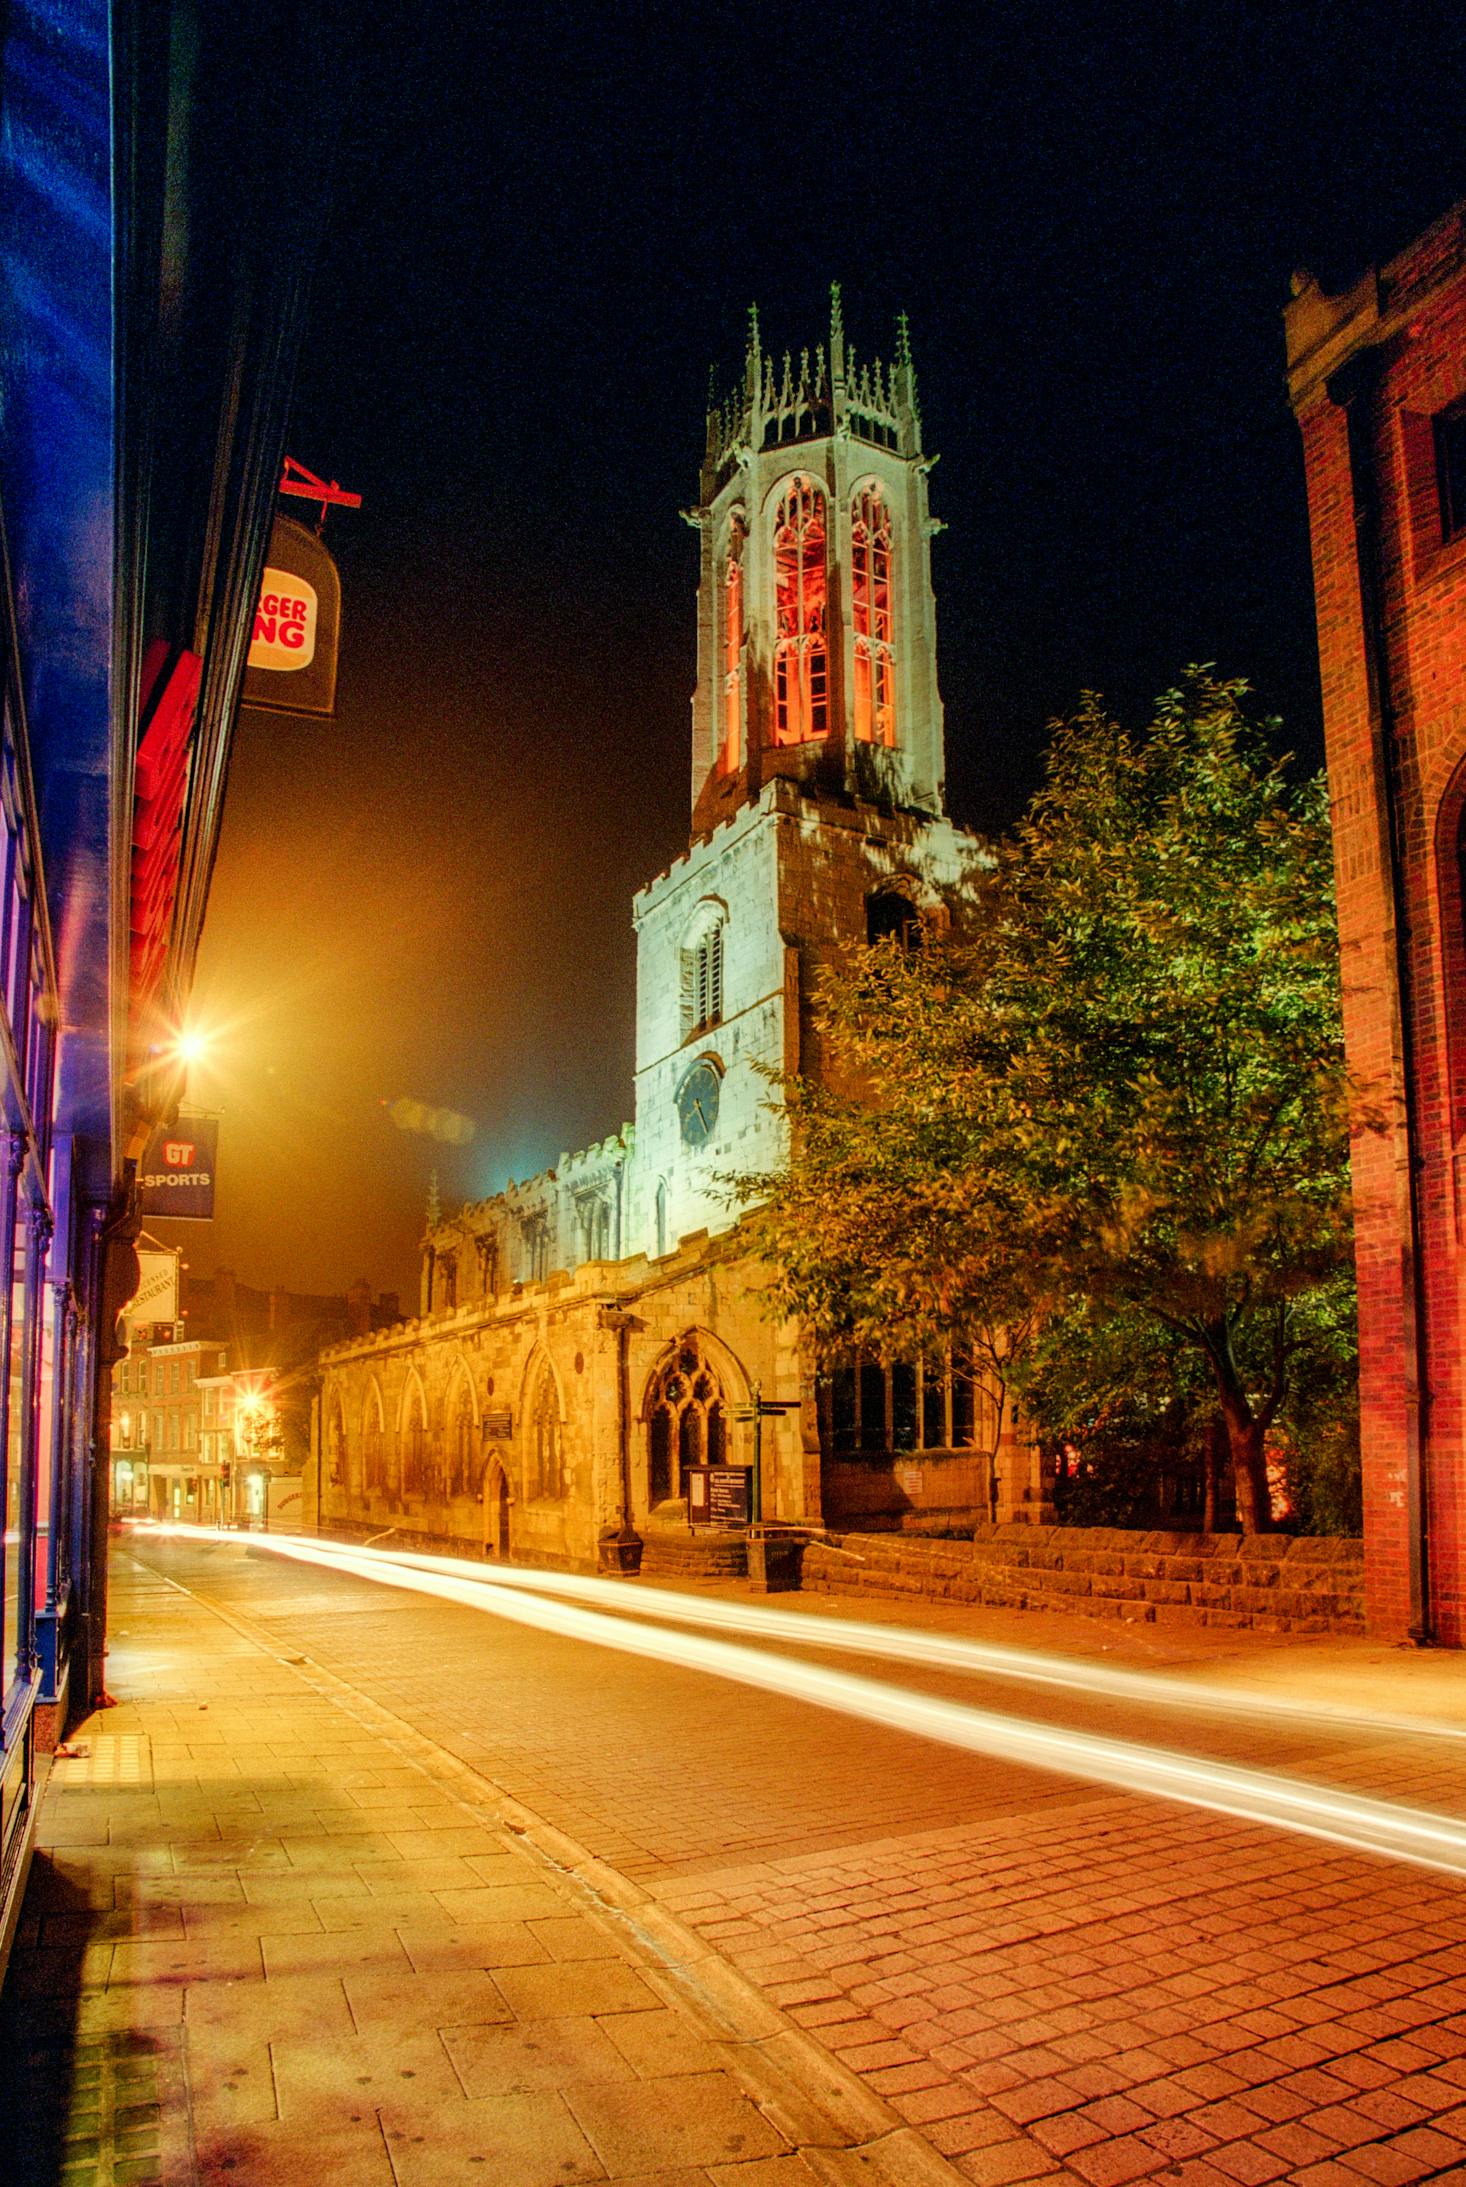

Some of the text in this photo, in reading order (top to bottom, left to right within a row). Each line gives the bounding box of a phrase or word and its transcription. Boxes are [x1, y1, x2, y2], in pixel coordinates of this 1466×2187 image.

[257, 594, 306, 621] GER
[166, 1143, 194, 1165] GT
[144, 1173, 210, 1187] SPORTS
